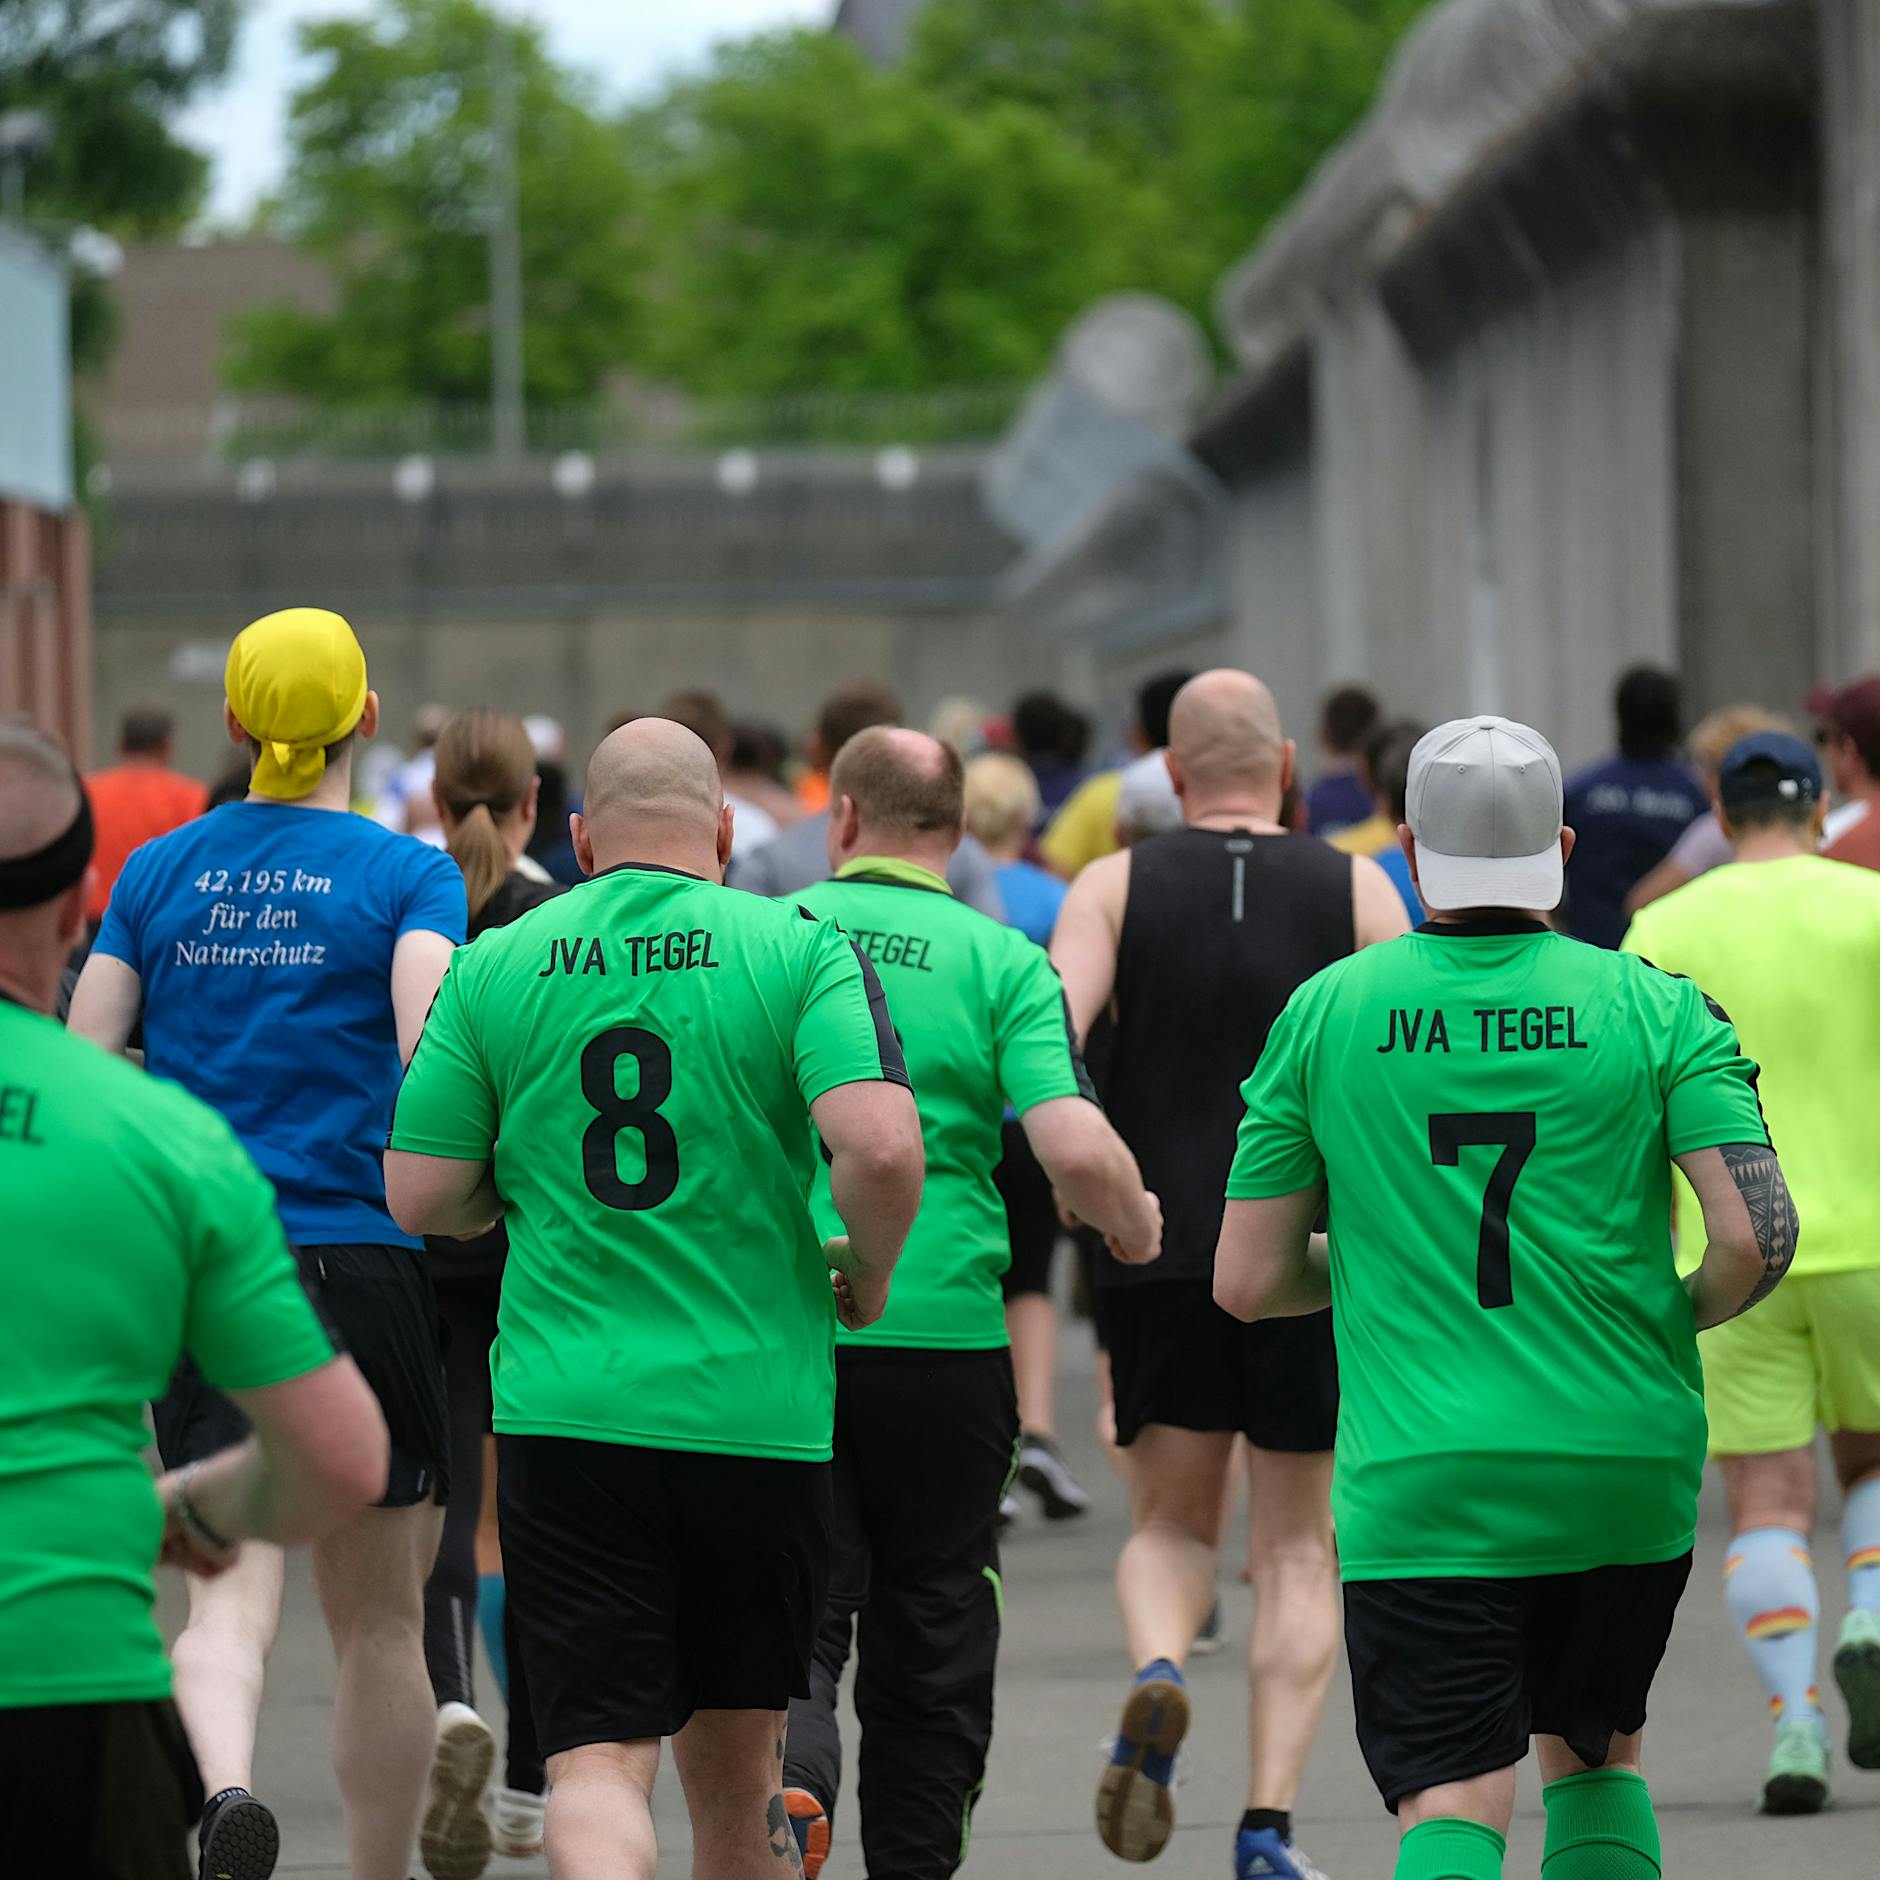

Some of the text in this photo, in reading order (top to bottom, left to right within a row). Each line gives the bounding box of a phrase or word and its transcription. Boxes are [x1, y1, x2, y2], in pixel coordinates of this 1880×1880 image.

[194, 868, 333, 896] 42,195 km
[202, 902, 298, 936] für den
[175, 939, 327, 967] Naturschutz
[538, 929, 719, 977] JVA TEGEL
[1376, 1006, 1588, 1053] JVA TEGEL
[580, 1026, 680, 1211] 8
[1428, 1111, 1537, 1310] 7
